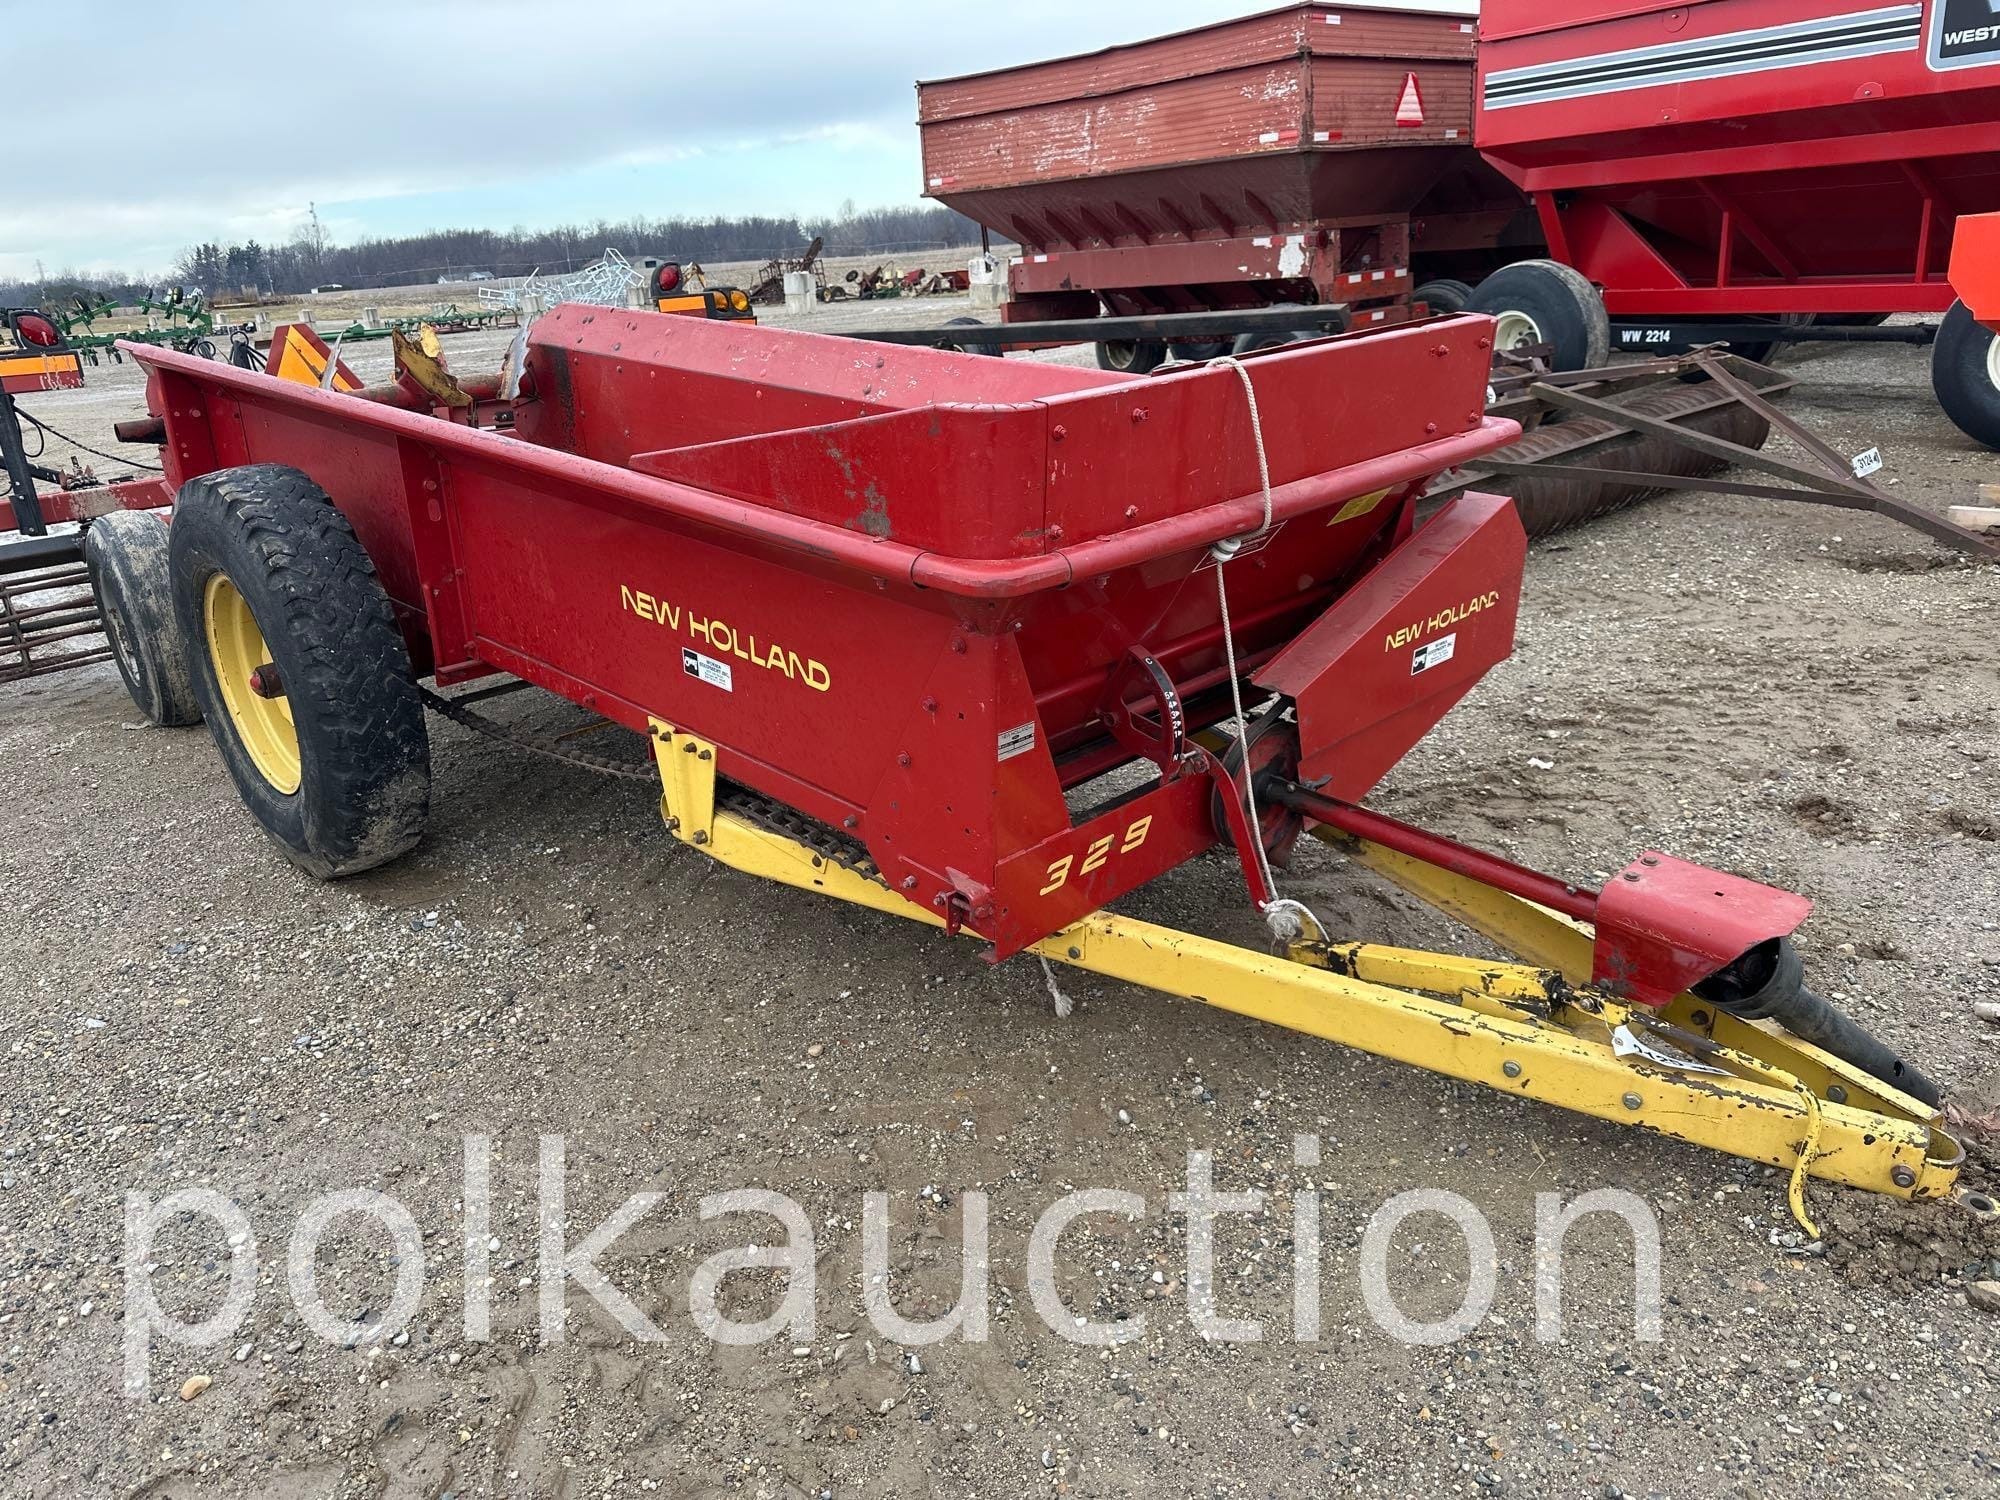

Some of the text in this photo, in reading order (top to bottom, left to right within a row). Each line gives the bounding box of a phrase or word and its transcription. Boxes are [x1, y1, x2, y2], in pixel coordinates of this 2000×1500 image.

[1944, 25, 2000, 46] WEST
[1621, 330, 1670, 343] WW 2214
[620, 584, 831, 692] NEW HOLLAND
[1384, 620, 1424, 653] NEW
[1426, 590, 1500, 634] HOLLAND
[1039, 814, 1153, 897] 329
